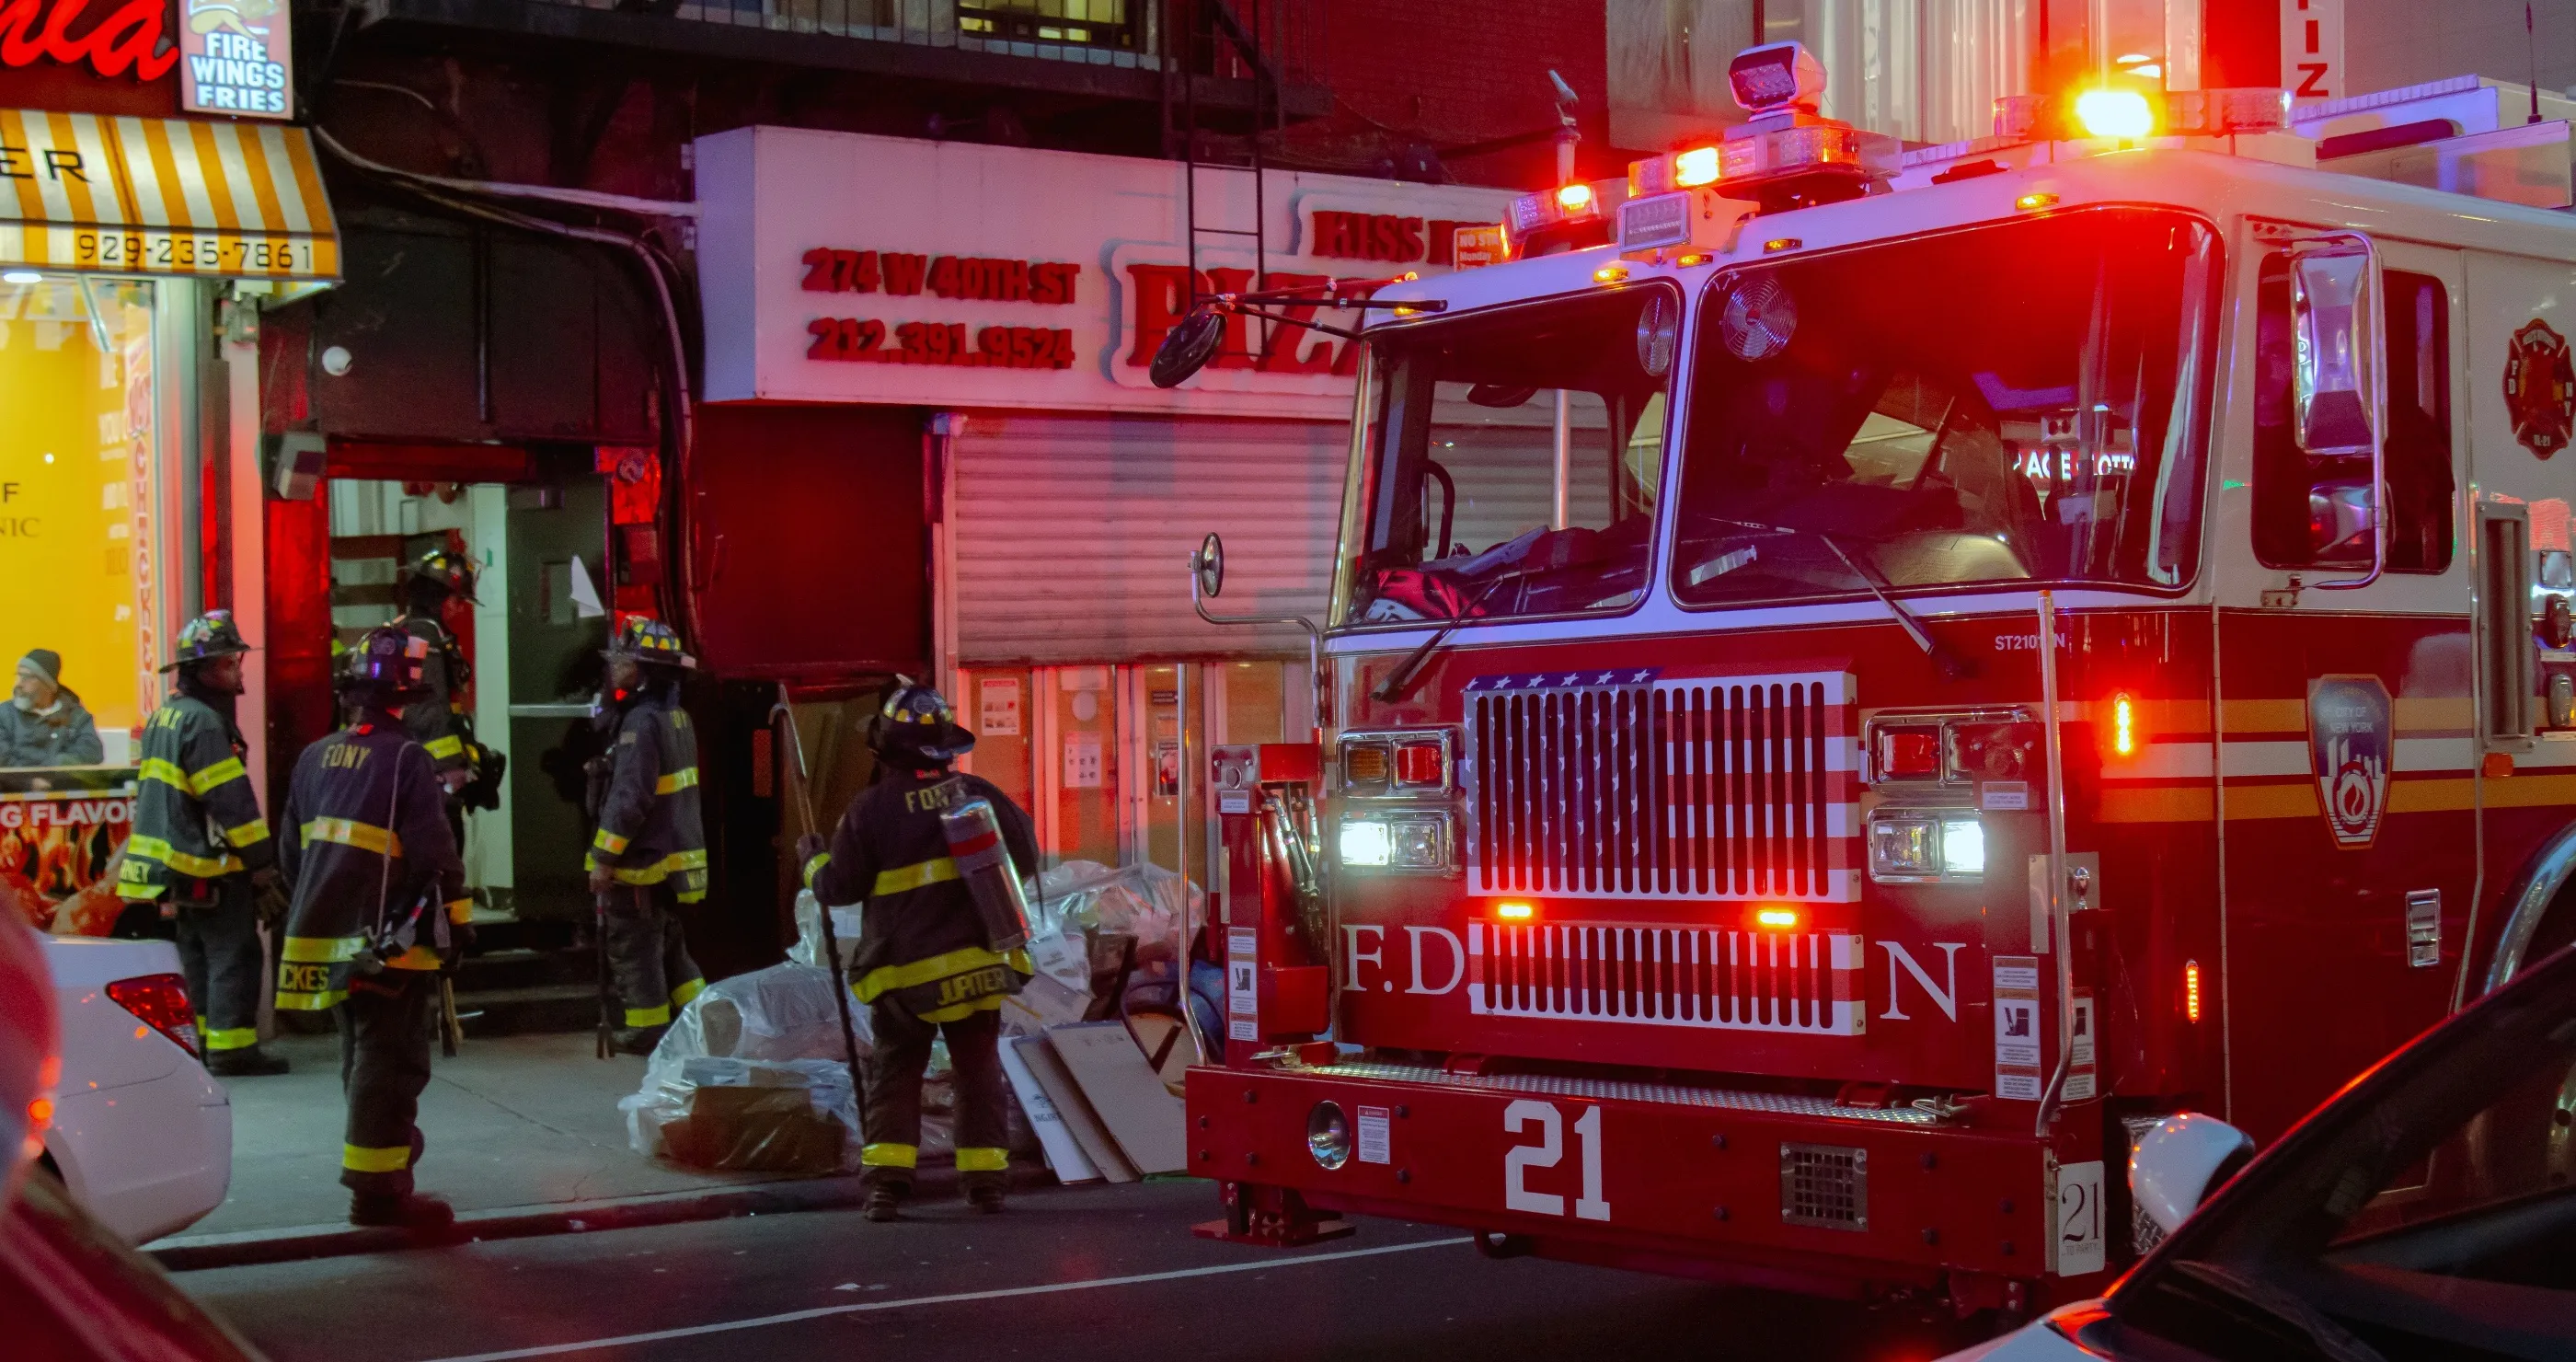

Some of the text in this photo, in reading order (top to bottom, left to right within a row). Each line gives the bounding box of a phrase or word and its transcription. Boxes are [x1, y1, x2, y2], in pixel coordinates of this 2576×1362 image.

[205, 32, 268, 62] FIRE
[2296, 0, 2329, 98] IZ
[189, 56, 285, 88] WINGS
[196, 84, 285, 110] FRIES
[78, 235, 314, 271] 929-235-7861
[1312, 211, 1424, 263] KISS
[1459, 234, 1476, 247] NO
[801, 248, 1081, 305] 274 W 40TH ST
[807, 317, 1075, 370] 212.391.9524
[320, 743, 373, 770] FDNY
[903, 786, 951, 814] FDN
[1875, 940, 1967, 1023] N
[1503, 1099, 1611, 1222] 21
[2062, 1181, 2100, 1244] 21
